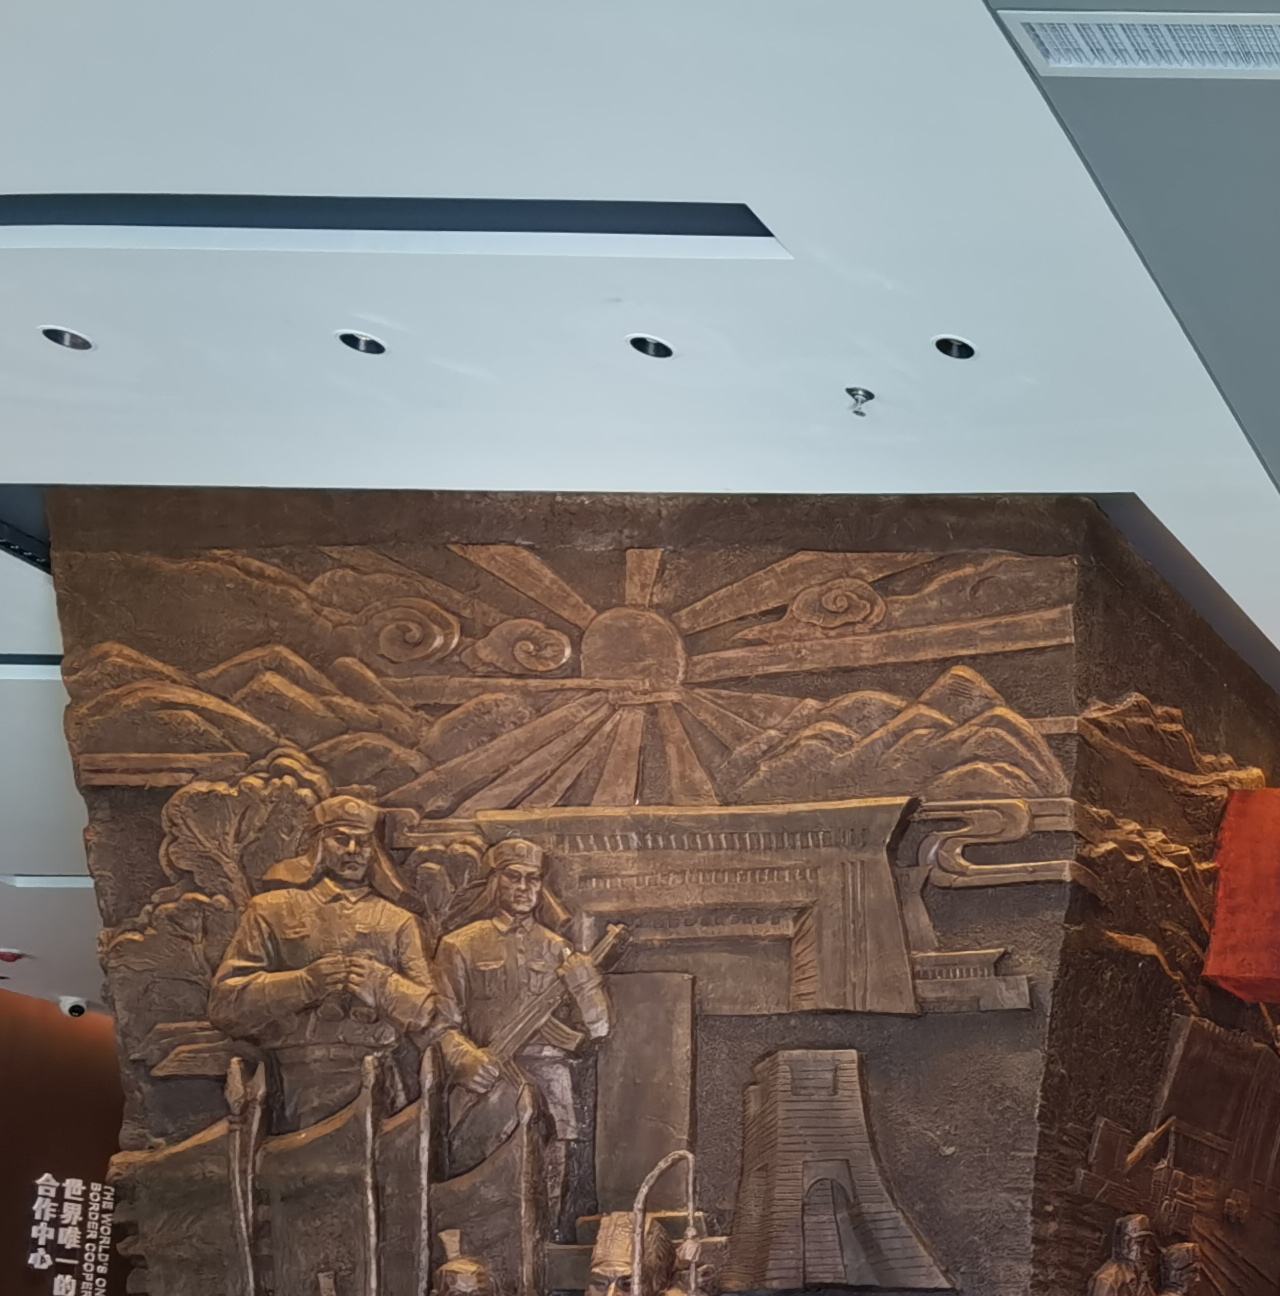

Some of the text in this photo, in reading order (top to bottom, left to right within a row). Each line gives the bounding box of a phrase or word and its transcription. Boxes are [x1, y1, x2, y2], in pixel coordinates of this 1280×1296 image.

[28, 1172, 61, 1270] 合作中心
[85, 1181, 102, 1239] BORDER
[102, 1184, 116, 1209] THE
[96, 1213, 115, 1275] WORLD'S
